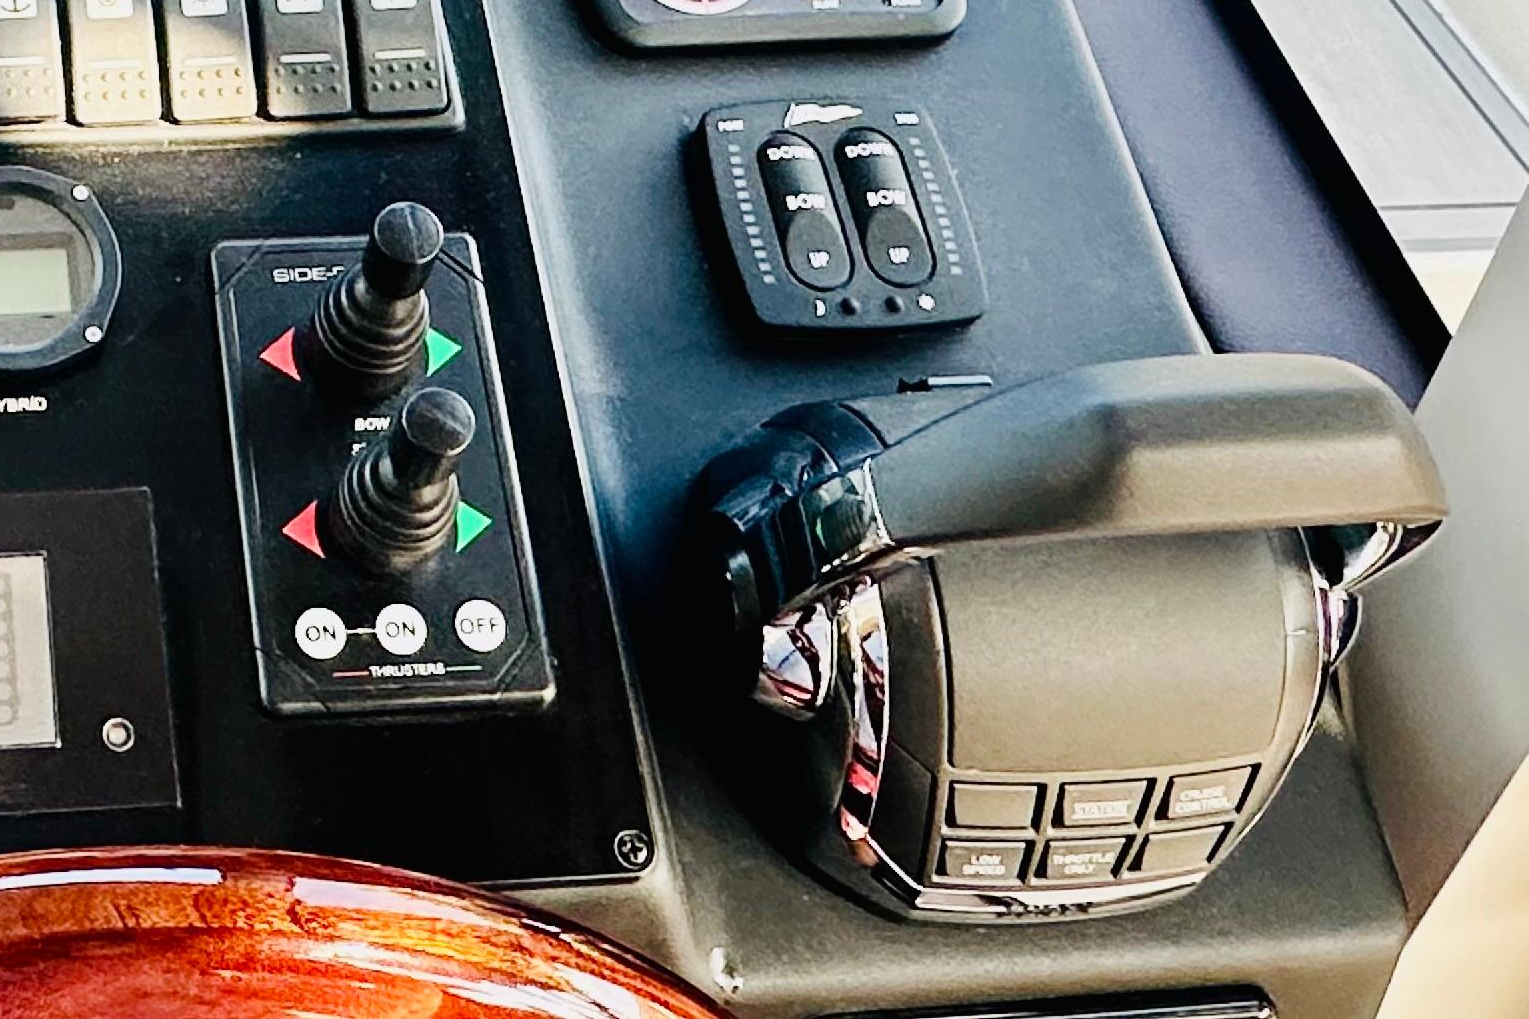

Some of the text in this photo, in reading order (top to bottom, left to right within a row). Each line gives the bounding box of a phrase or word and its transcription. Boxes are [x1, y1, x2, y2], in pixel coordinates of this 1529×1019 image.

[354, 416, 391, 432] BOW
[305, 624, 337, 642] ON
[385, 621, 416, 638] ON
[460, 617, 499, 635] OFF
